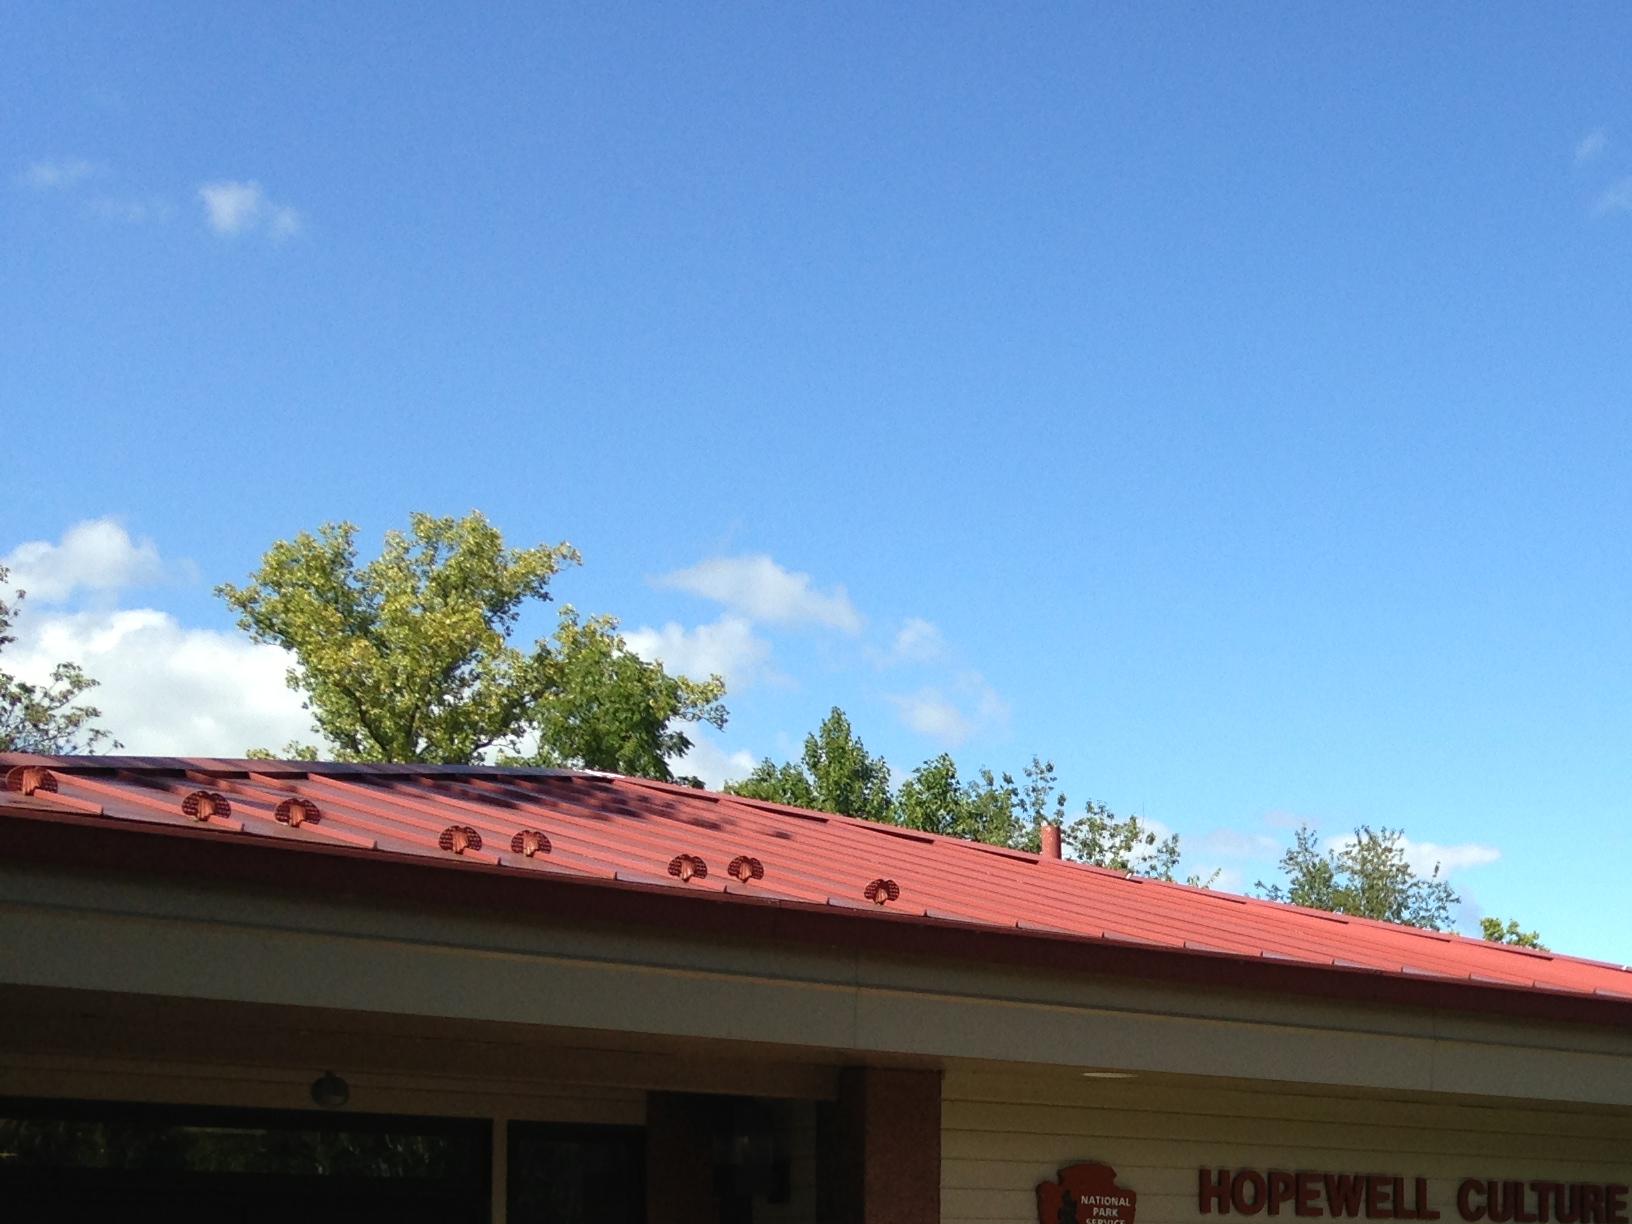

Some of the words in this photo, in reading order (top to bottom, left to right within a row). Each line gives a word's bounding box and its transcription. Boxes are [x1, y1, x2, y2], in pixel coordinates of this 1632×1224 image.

[1197, 1167, 1441, 1220] HOPEWELL
[1081, 1195, 1131, 1206] NATIONAL
[1093, 1207, 1118, 1217] PARK
